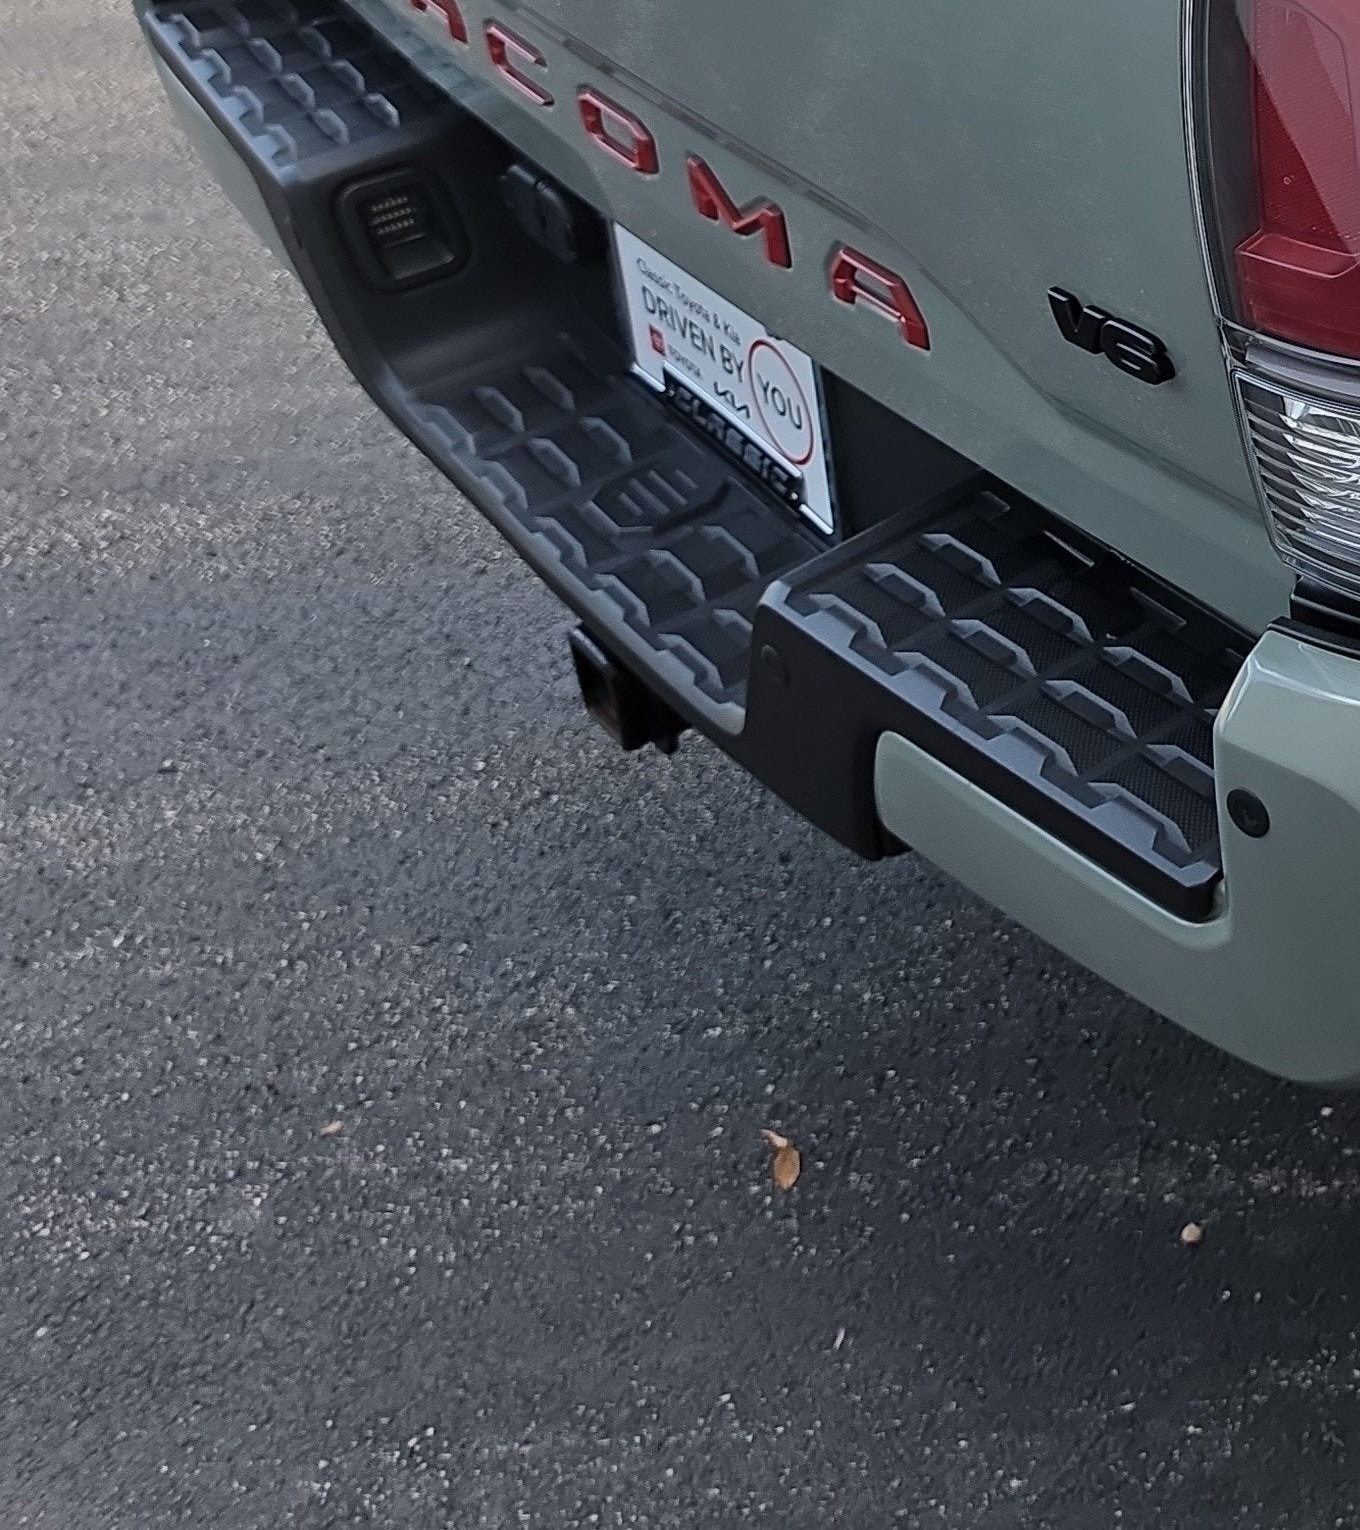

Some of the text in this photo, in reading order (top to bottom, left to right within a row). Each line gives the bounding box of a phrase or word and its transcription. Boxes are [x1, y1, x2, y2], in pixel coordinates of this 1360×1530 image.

[673, 282, 711, 323] Toyota
[1047, 285, 1176, 386] V6
[641, 284, 802, 431] DRIVEN BY YOU
